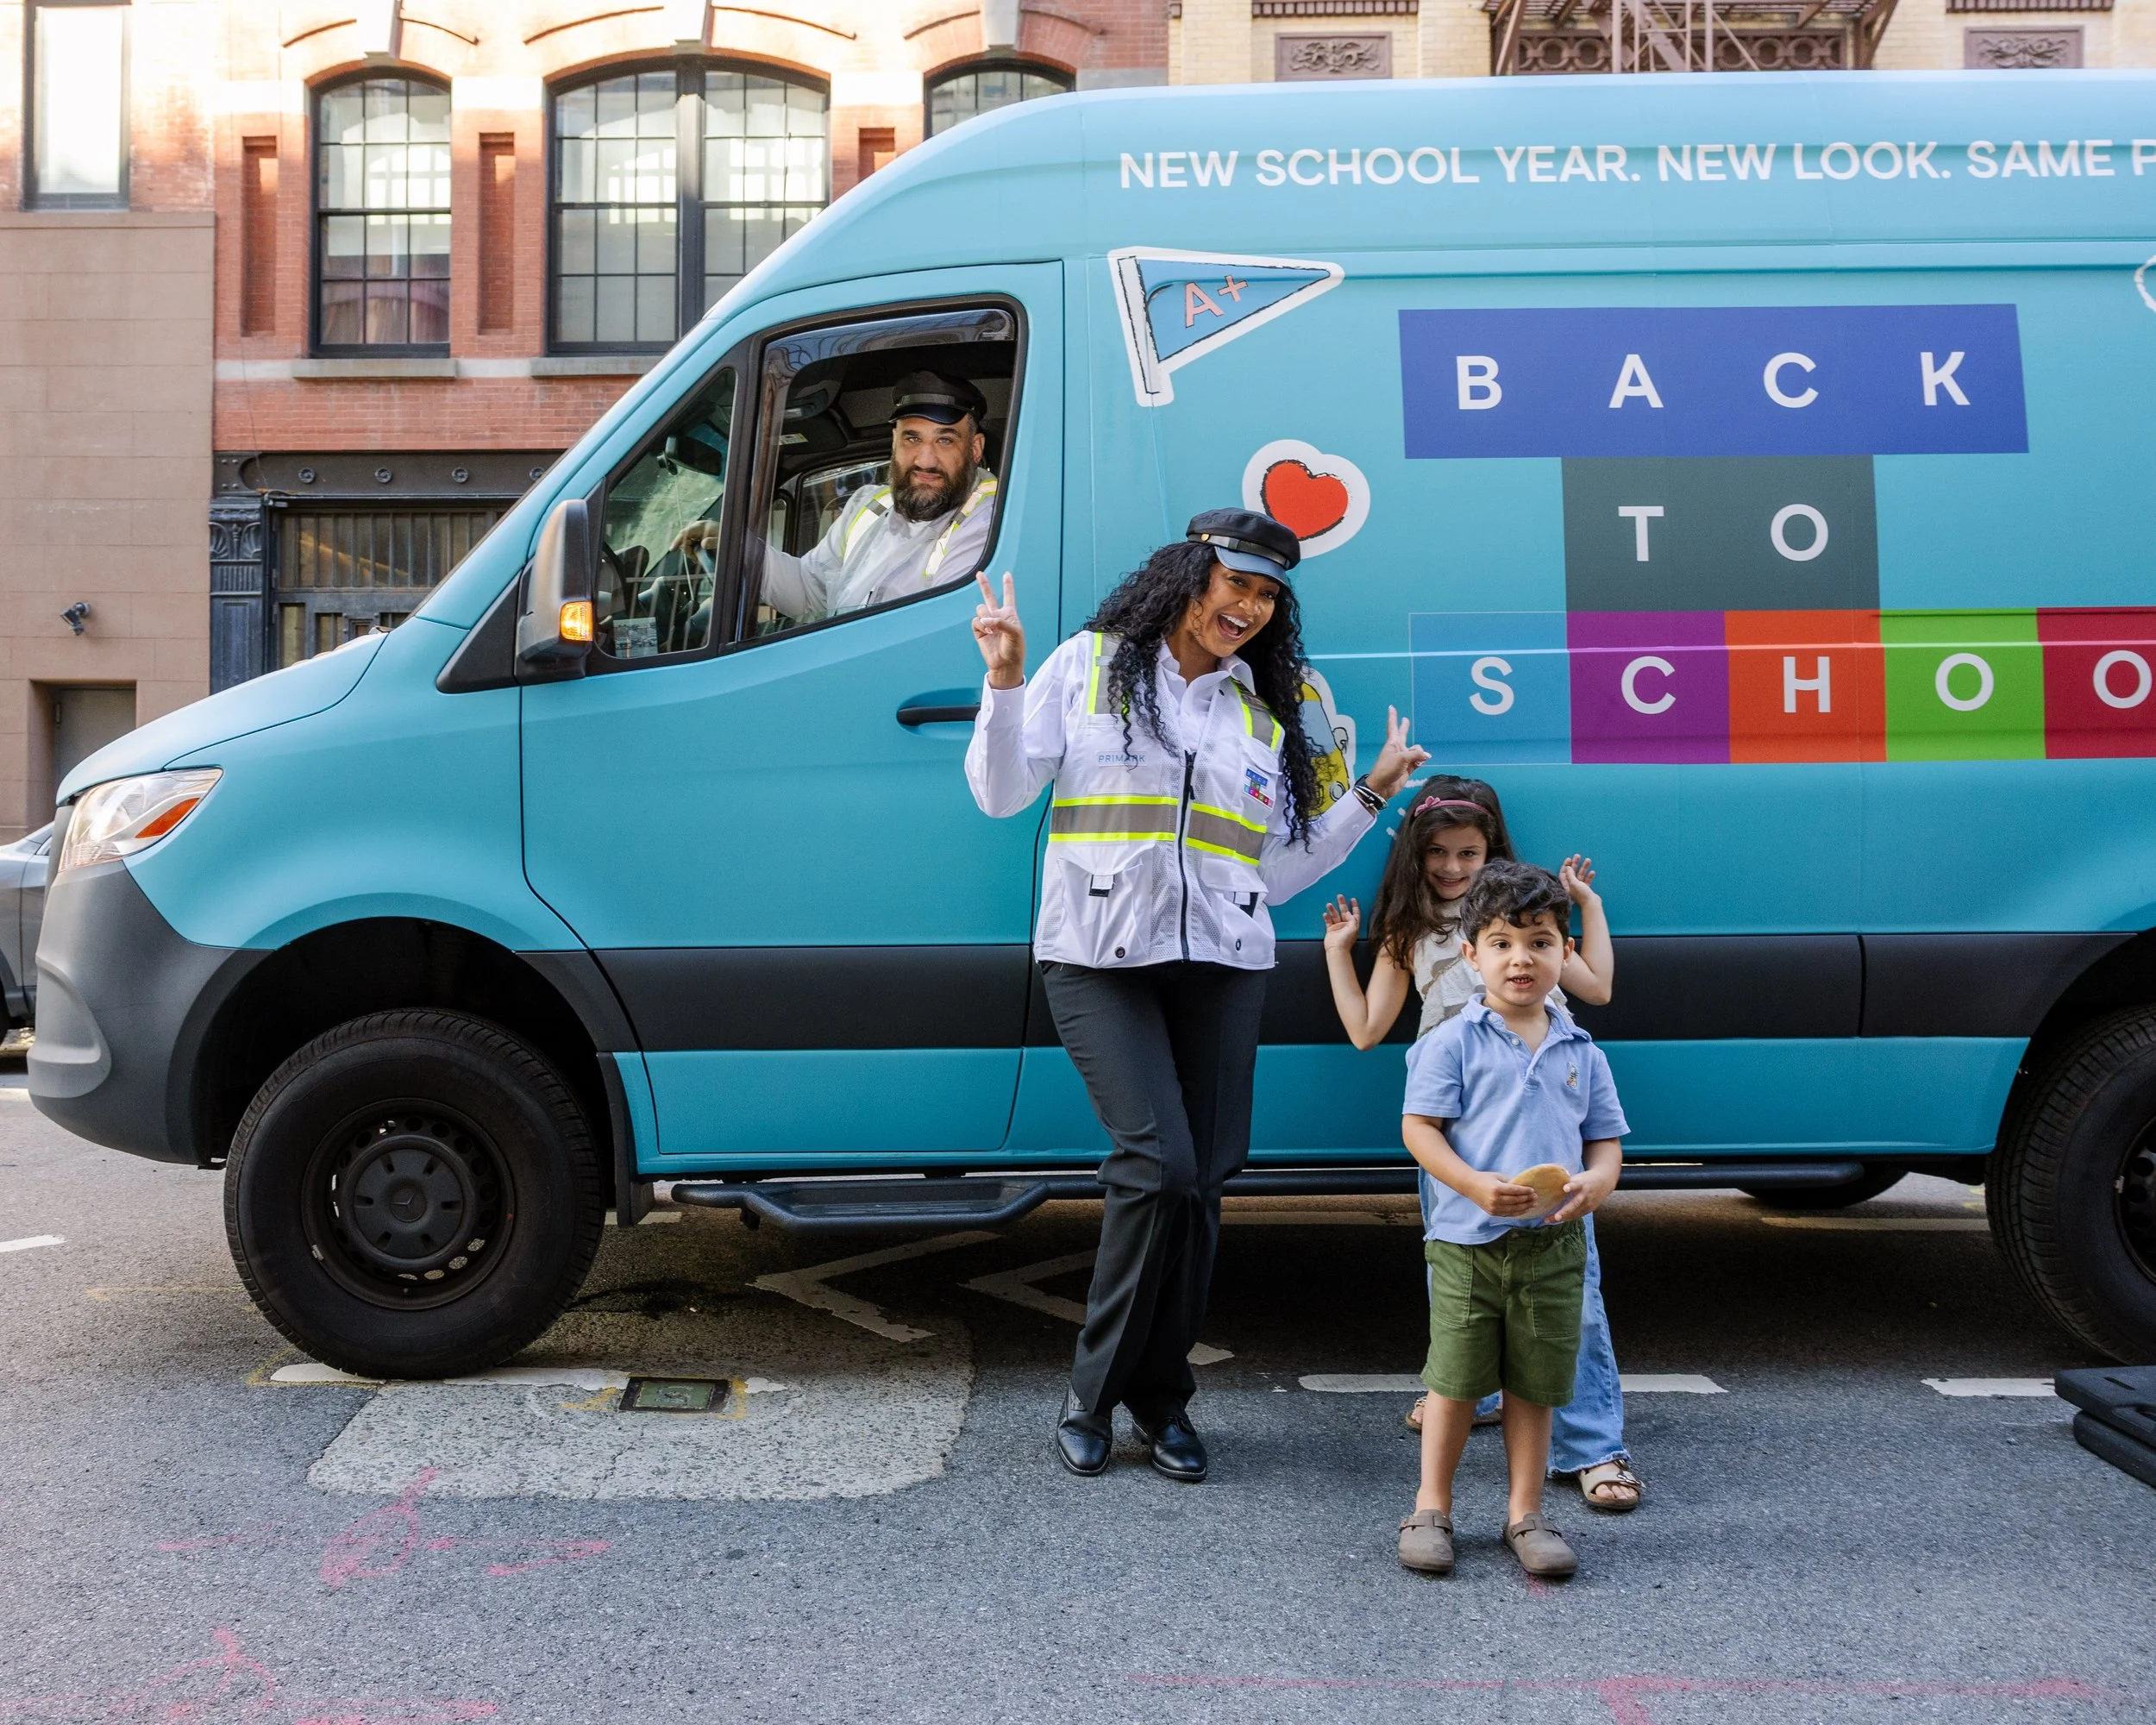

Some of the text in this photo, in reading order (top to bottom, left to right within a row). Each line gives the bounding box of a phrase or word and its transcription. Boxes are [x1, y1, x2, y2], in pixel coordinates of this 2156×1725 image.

[1119, 148, 1239, 190] NEW
[1255, 146, 1481, 187] SCHOOL
[1493, 143, 1642, 184] YEAR.
[1658, 142, 1777, 183] NEW
[1793, 140, 1952, 180] LOOK.
[1966, 139, 2117, 179] SAME
[1455, 351, 1971, 411] BACK
[1618, 504, 1829, 561] TO
[1469, 649, 2153, 715] SCHOO
[1098, 754, 1146, 762] PRIMARK
